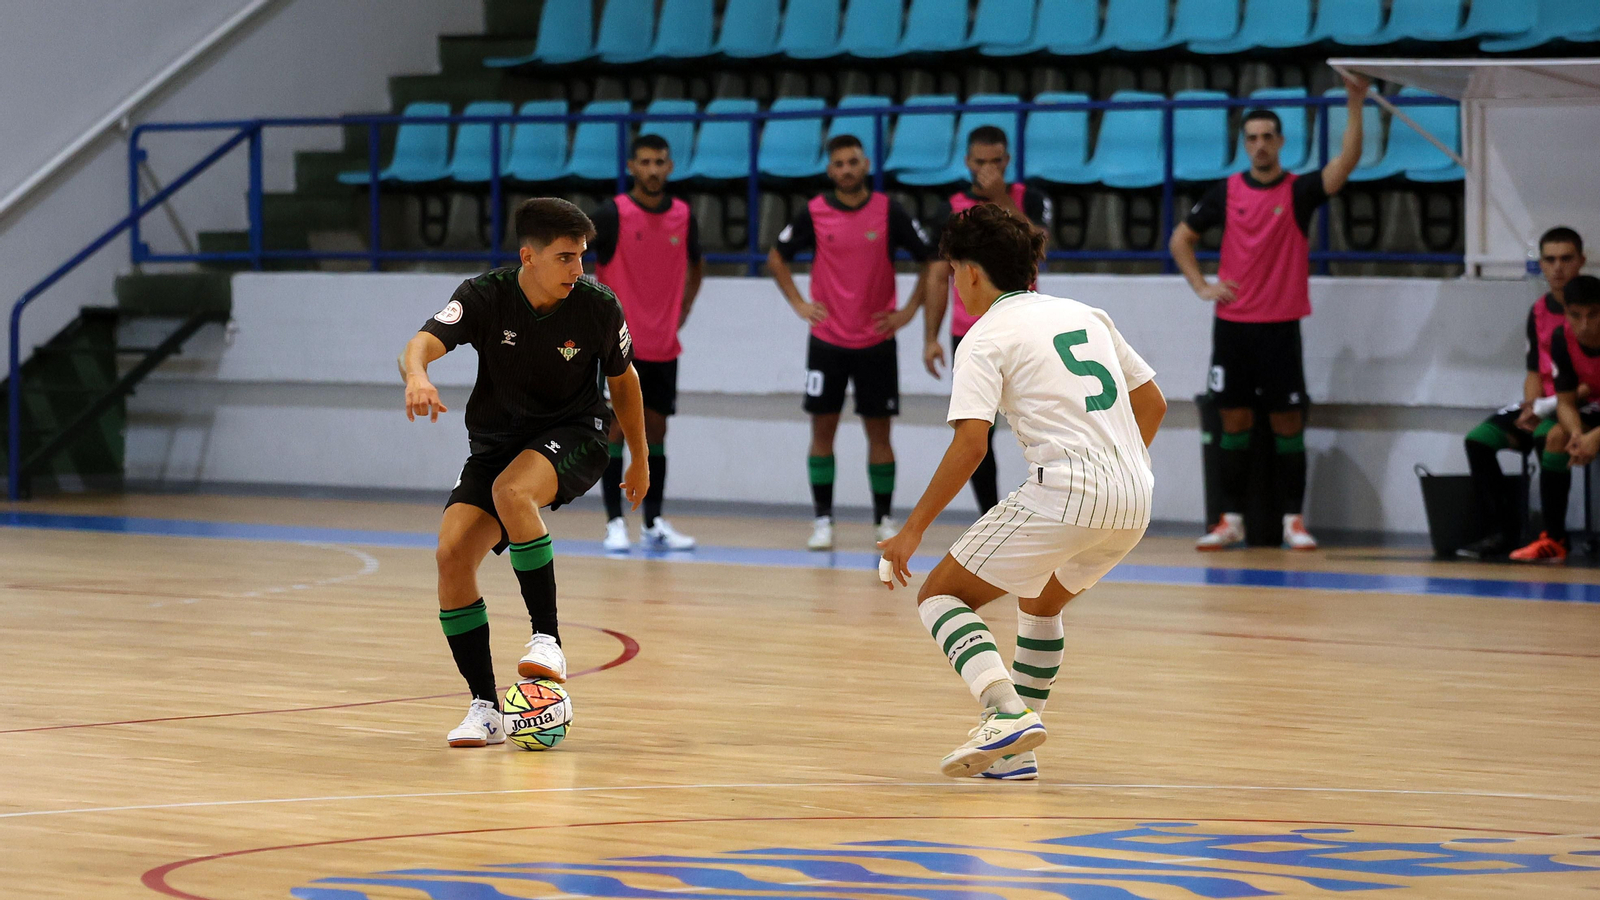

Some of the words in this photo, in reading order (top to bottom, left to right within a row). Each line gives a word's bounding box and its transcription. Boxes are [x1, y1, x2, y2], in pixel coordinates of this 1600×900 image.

[806, 370, 825, 397] 0
[1053, 329, 1118, 413] 5
[1209, 365, 1226, 393] 3
[949, 634, 983, 666] OVA
